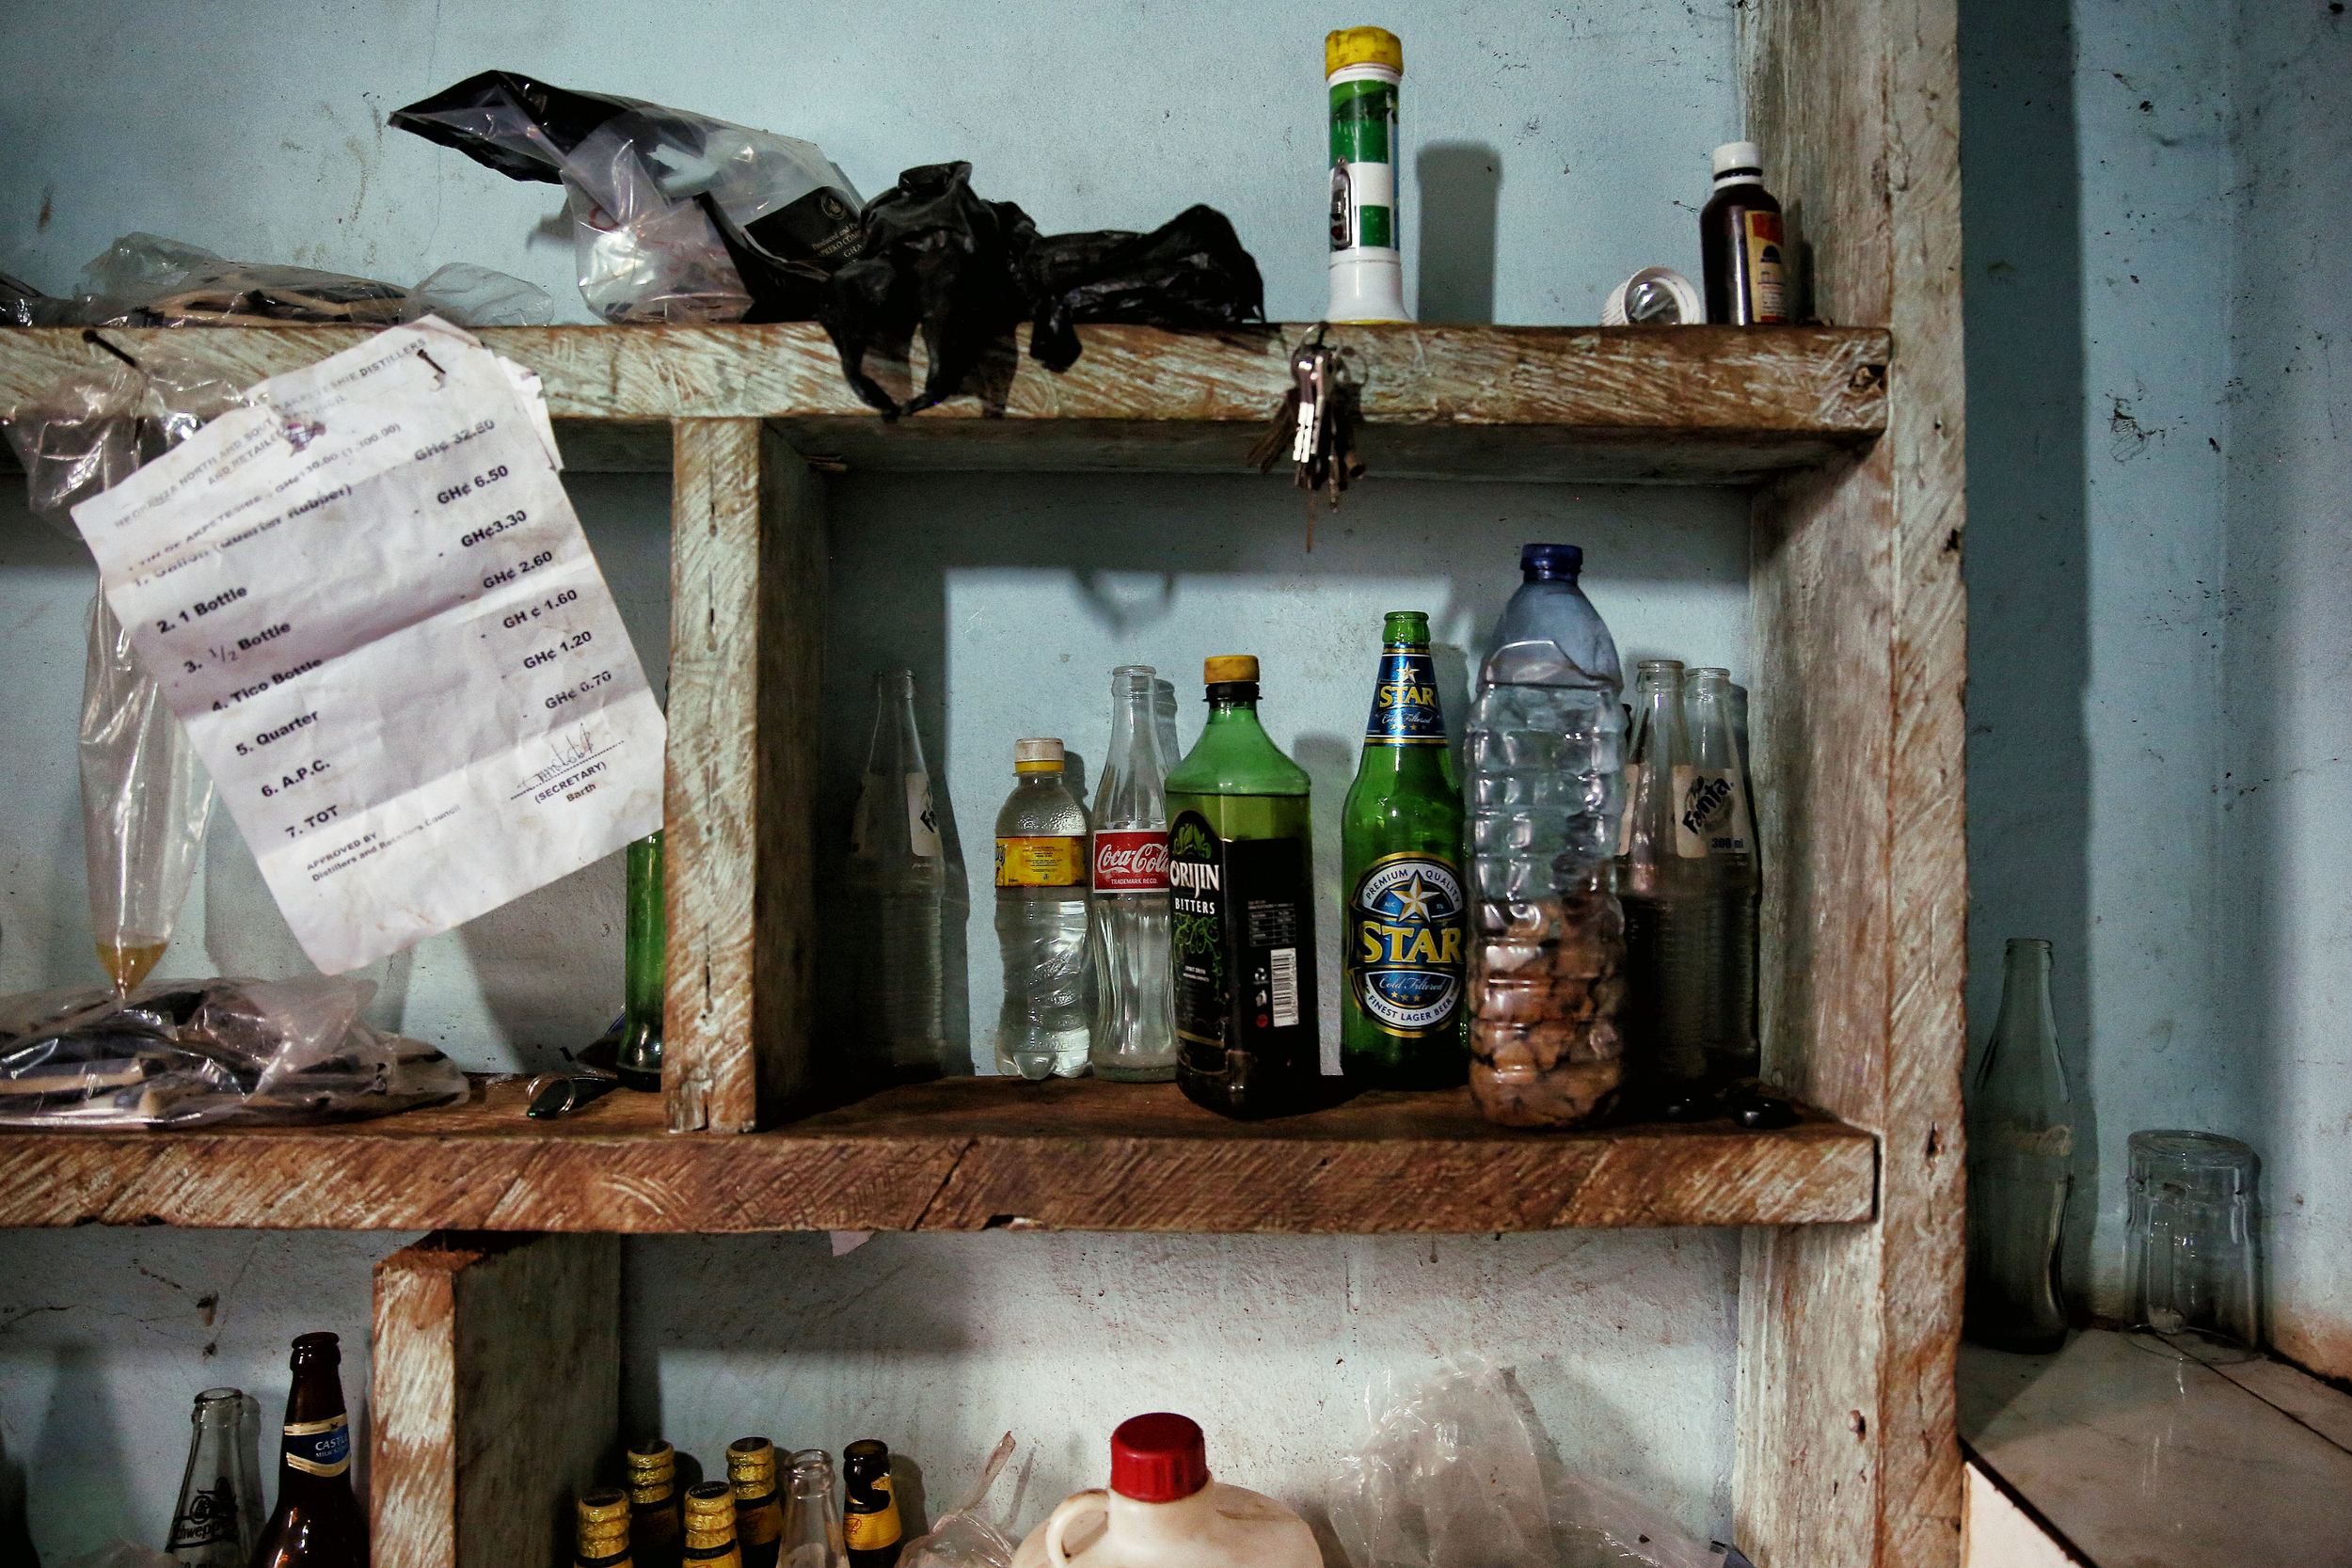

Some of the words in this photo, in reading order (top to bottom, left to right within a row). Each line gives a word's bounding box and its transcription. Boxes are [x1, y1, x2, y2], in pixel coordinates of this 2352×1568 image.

[839, 225, 850, 237] and
[179, 453, 217, 487] NORTH
[218, 436, 245, 462] AND
[359, 338, 427, 378] DISTILLERS
[207, 464, 231, 486] AND
[157, 619, 176, 635] 2.
[179, 610, 190, 623] 1
[192, 586, 248, 617] Bottle
[473, 464, 509, 488] 6.50
[230, 680, 270, 705] Tico
[271, 657, 324, 687] Bottle
[518, 550, 553, 575] 2.60
[183, 659, 202, 674] 3.
[237, 621, 293, 652] Bottle
[235, 742, 254, 757] 5.
[256, 710, 320, 748] Quarter
[544, 589, 578, 611] 1.60
[261, 784, 278, 799] 6.
[281, 758, 331, 789] A.P.C.
[560, 630, 592, 653] 1.20
[1379, 686, 1436, 707] STAR
[285, 825, 303, 839] 7.
[304, 804, 340, 830] TOT
[580, 670, 612, 694] 0.70
[533, 760, 608, 805] (SECRETARY)
[565, 782, 597, 803] Barth
[1682, 775, 1732, 835] Fanta
[307, 837, 362, 871] APPROVED
[363, 832, 377, 845] BY
[311, 857, 358, 882] Distillers
[359, 844, 377, 859] and
[1097, 843, 1169, 874] Coca-Cola
[1169, 860, 1220, 899] ORIJIN
[1365, 869, 1408, 900] PREMIUM
[1425, 870, 1460, 903] QUALITY
[1358, 920, 1464, 964] STAR
[1379, 974, 1403, 990] Cold
[1404, 974, 1448, 990] Filtered
[1368, 994, 1399, 1019] FINEST
[1401, 1011, 1432, 1022] LAGER
[1434, 998, 1454, 1016] BEER
